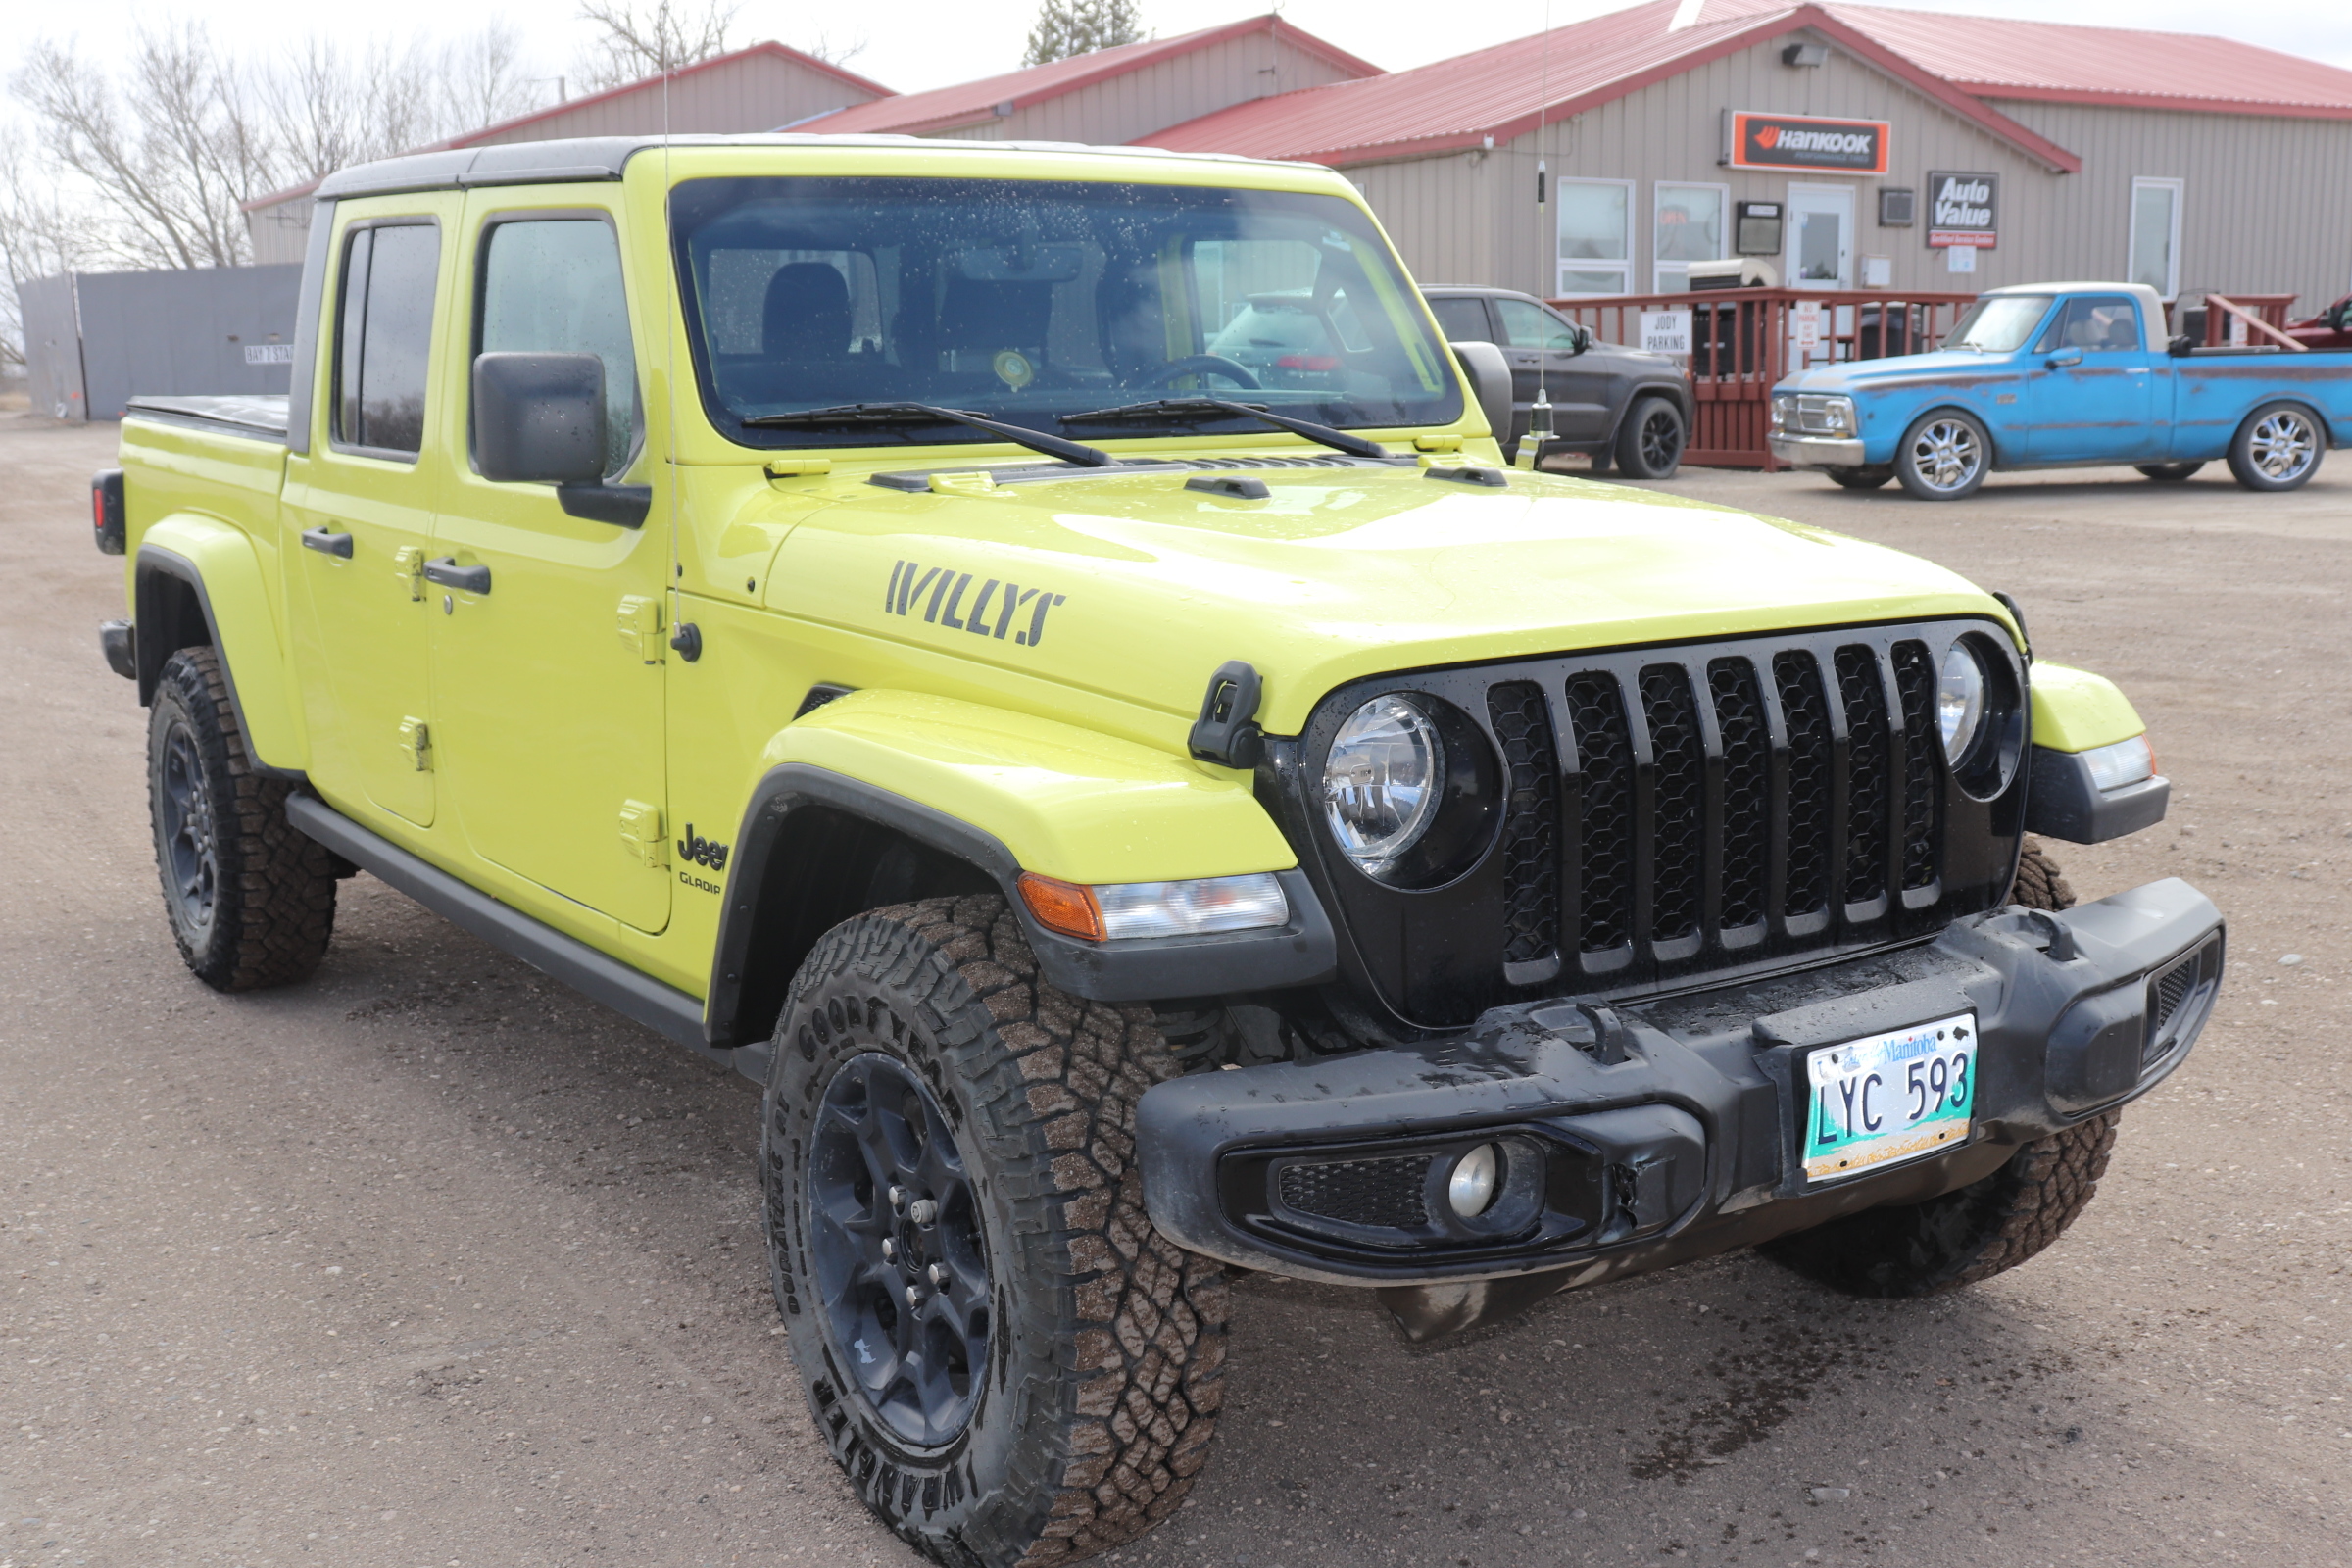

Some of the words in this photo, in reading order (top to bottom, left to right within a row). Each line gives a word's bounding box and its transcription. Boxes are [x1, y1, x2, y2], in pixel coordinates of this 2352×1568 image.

[1938, 177, 1990, 204] Auto
[1936, 201, 1992, 226] Value
[1804, 303, 1813, 313] NO
[1655, 315, 1677, 330] JODY
[1647, 335, 1685, 350] PARKING
[246, 347, 262, 362] BAY
[1883, 1035, 1936, 1064] Manitoba
[1818, 1073, 1883, 1146] LYC
[1907, 1053, 1969, 1120] 593
